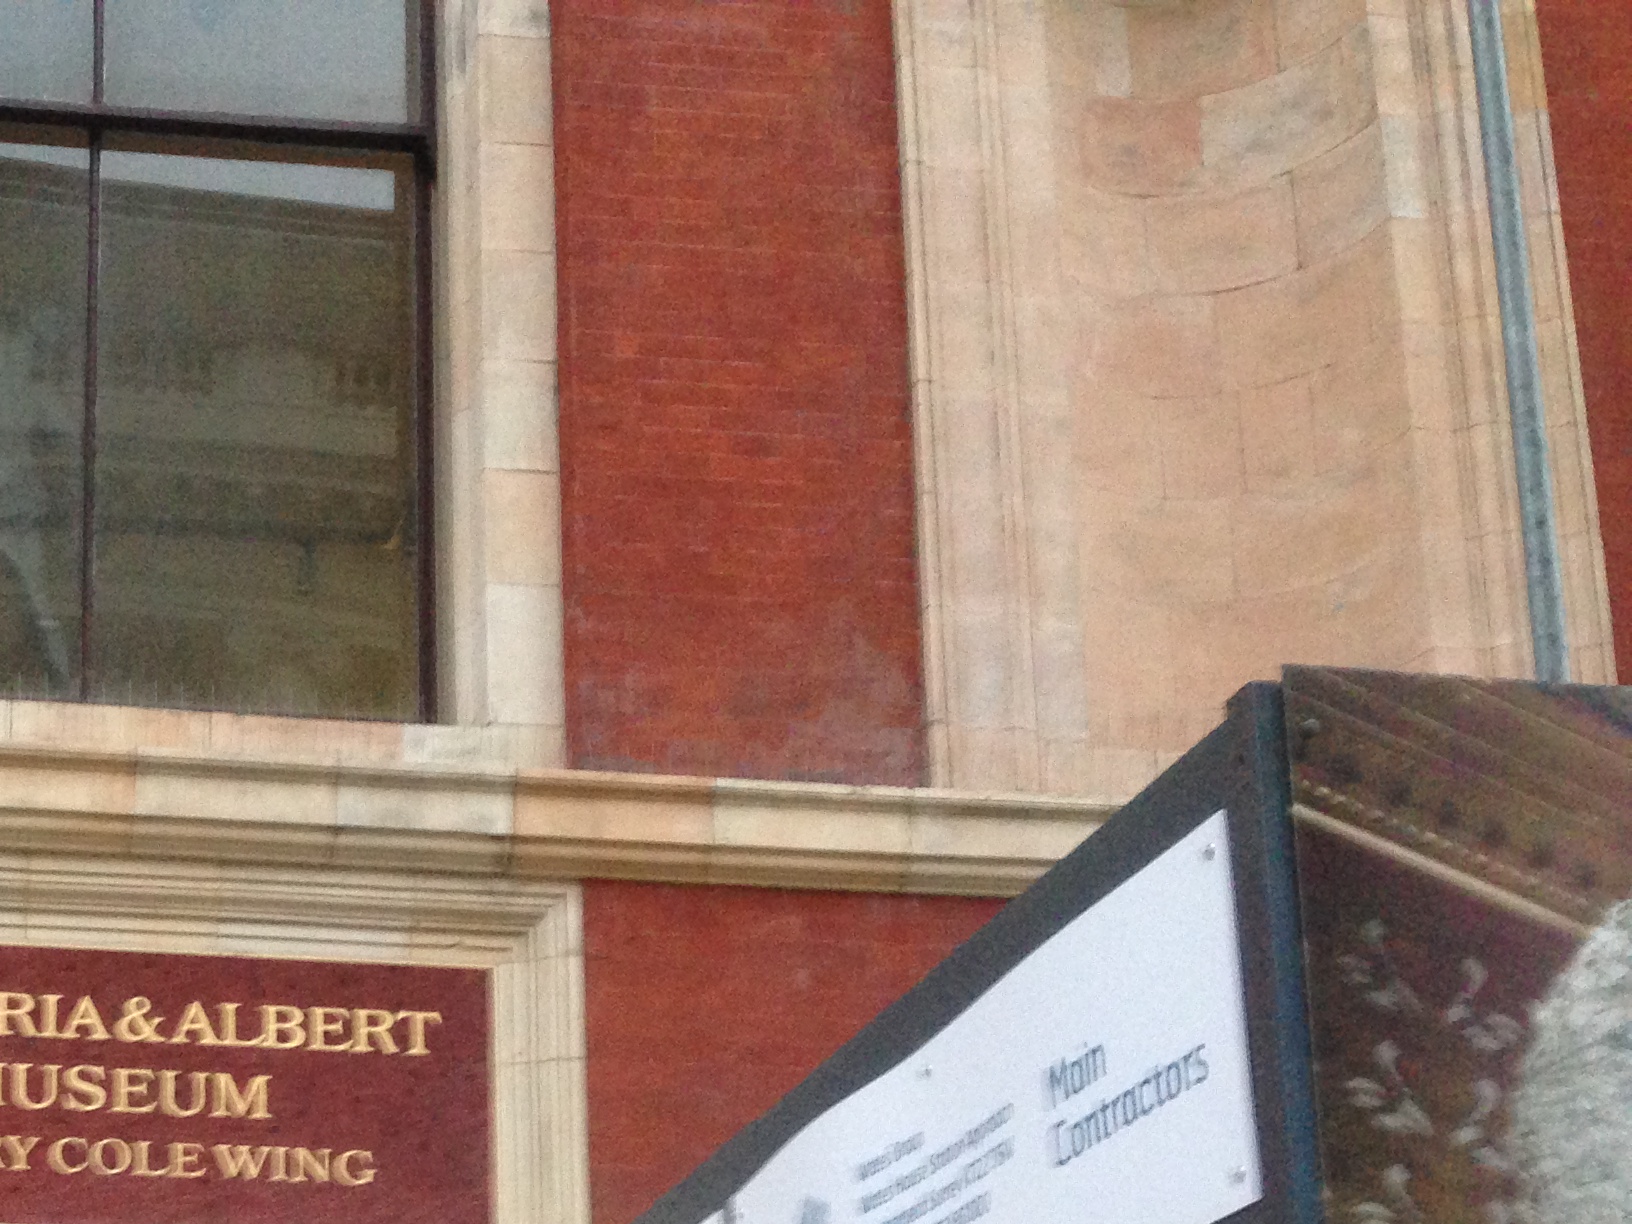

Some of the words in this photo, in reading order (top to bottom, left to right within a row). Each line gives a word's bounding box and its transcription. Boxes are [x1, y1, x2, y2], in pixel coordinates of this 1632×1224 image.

[1047, 1041, 1107, 1110] Main
[1048, 1043, 1210, 1168] Contractors
[47, 1136, 208, 1179] COLE
[211, 1143, 378, 1187] WING
